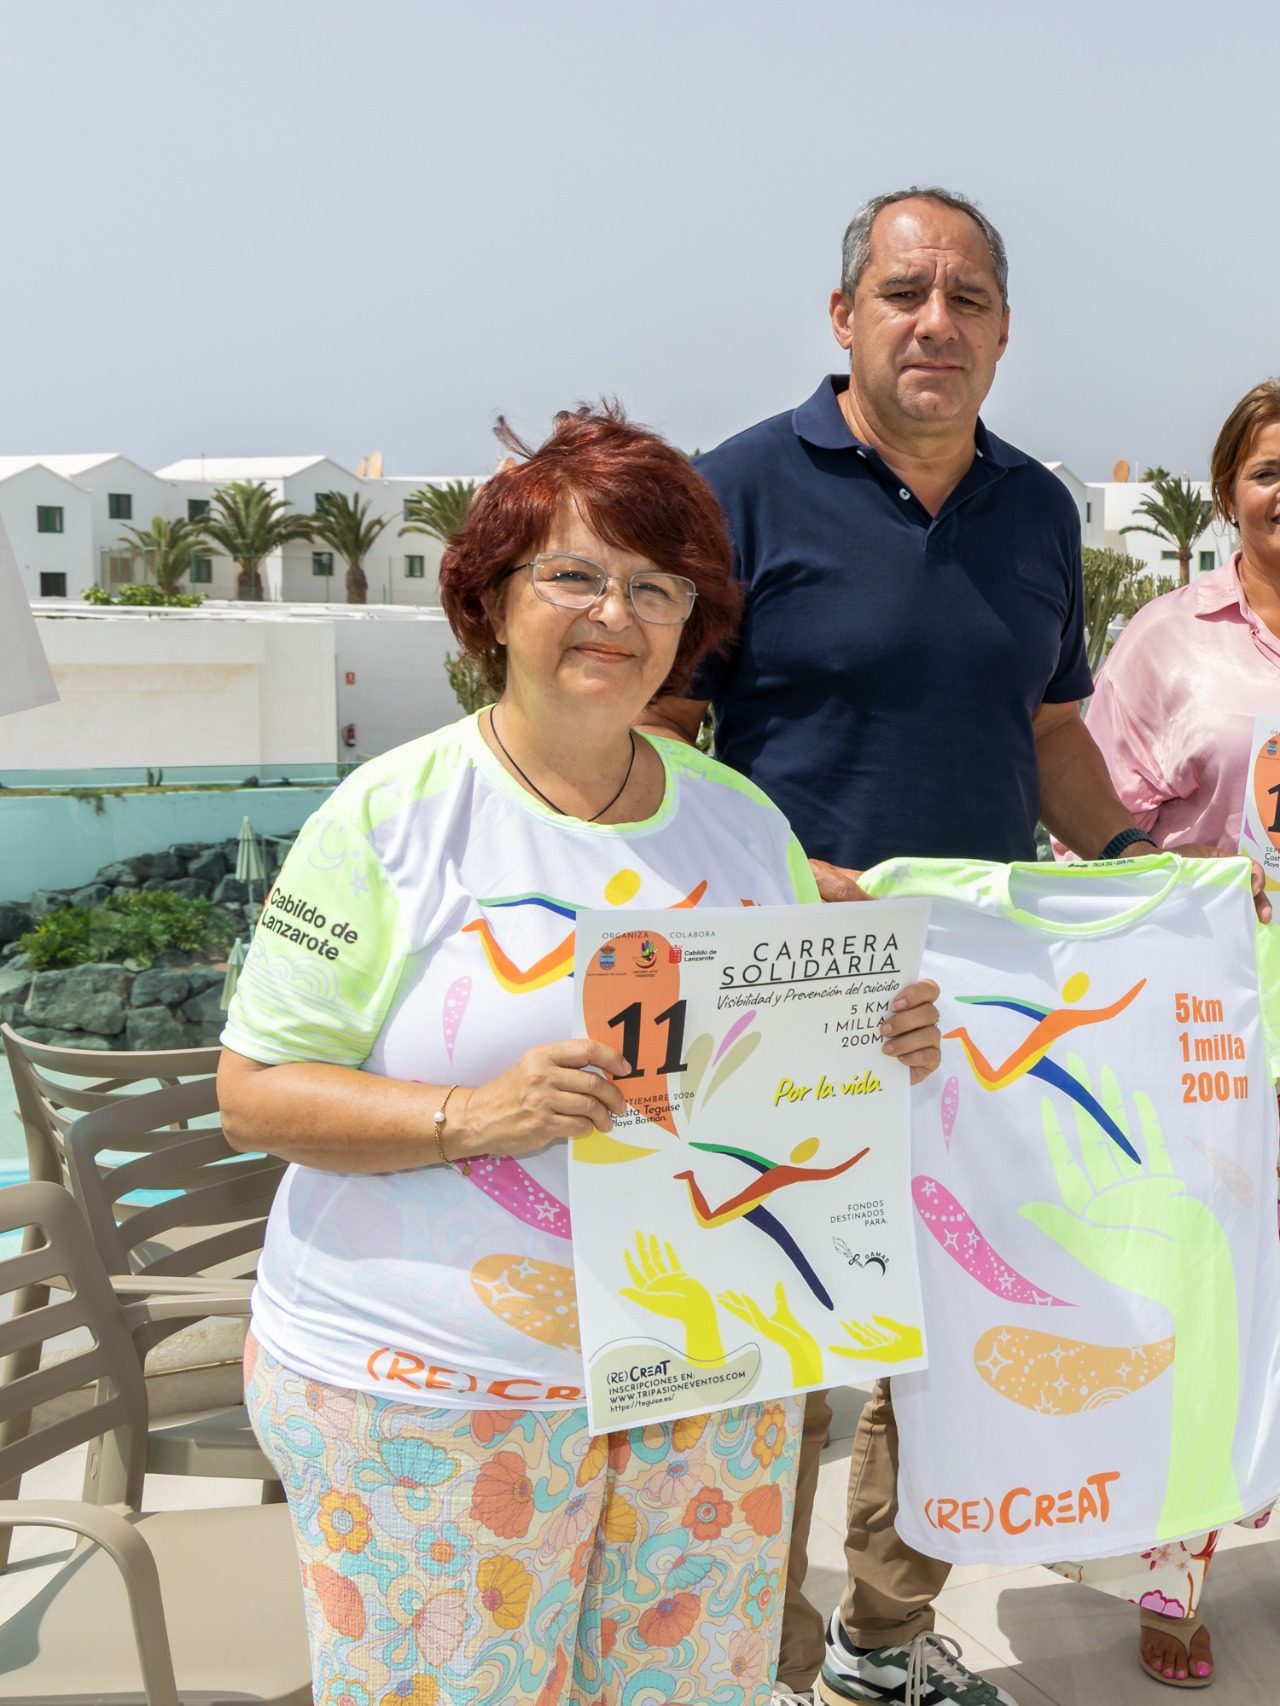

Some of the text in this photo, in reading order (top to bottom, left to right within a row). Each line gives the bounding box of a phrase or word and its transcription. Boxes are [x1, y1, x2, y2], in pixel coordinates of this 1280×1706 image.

[270, 887, 358, 944] Cabildo de
[261, 908, 339, 961] Lanzarote
[602, 930, 716, 940] ORGANIZA COLABORA
[753, 932, 899, 962] CARRERA
[721, 953, 896, 986] SOLIDARIA
[717, 979, 900, 1010] Visibilidad y Prevención del suicidio
[850, 1000, 889, 1015] 5 KM
[607, 999, 688, 1081] 11
[824, 1016, 886, 1034] 1 MILLA
[841, 1034, 884, 1048] 200M
[1179, 1031, 1246, 1062] 1 milla
[626, 1091, 695, 1105] TIEMBRE 2026
[773, 1068, 883, 1107] Por la vida
[1181, 1070, 1249, 1103] 200 m
[643, 1103, 681, 1117] Teguise
[830, 1208, 885, 1224] DESTINADOS
[847, 1199, 884, 1211] FONDOS
[366, 1347, 586, 1401] (RE)CR
[609, 1376, 678, 1395] INSCRIPCIONES
[609, 1371, 746, 1404] WWW.TRIPASIONEVENTOS.COM
[610, 1394, 675, 1413] https://teguise.es/
